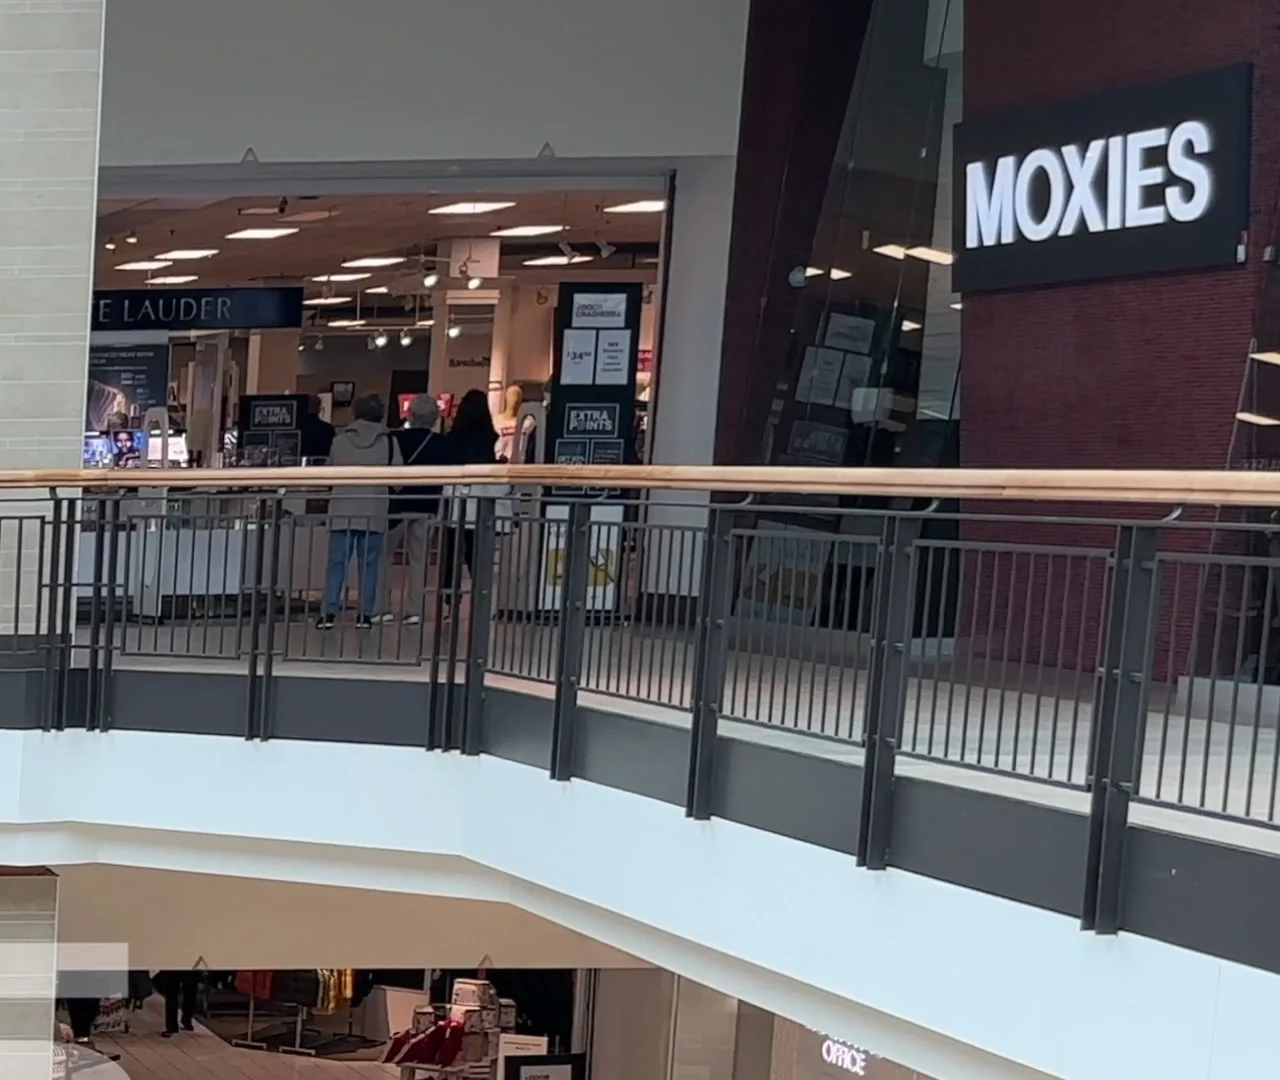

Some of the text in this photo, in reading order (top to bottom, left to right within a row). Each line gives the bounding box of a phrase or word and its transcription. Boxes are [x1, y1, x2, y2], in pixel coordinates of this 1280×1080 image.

[965, 120, 1214, 249] MOXIES
[123, 297, 232, 322] LAUDER
[569, 410, 609, 420] EXTRA
[821, 1039, 867, 1076] OFFICE
